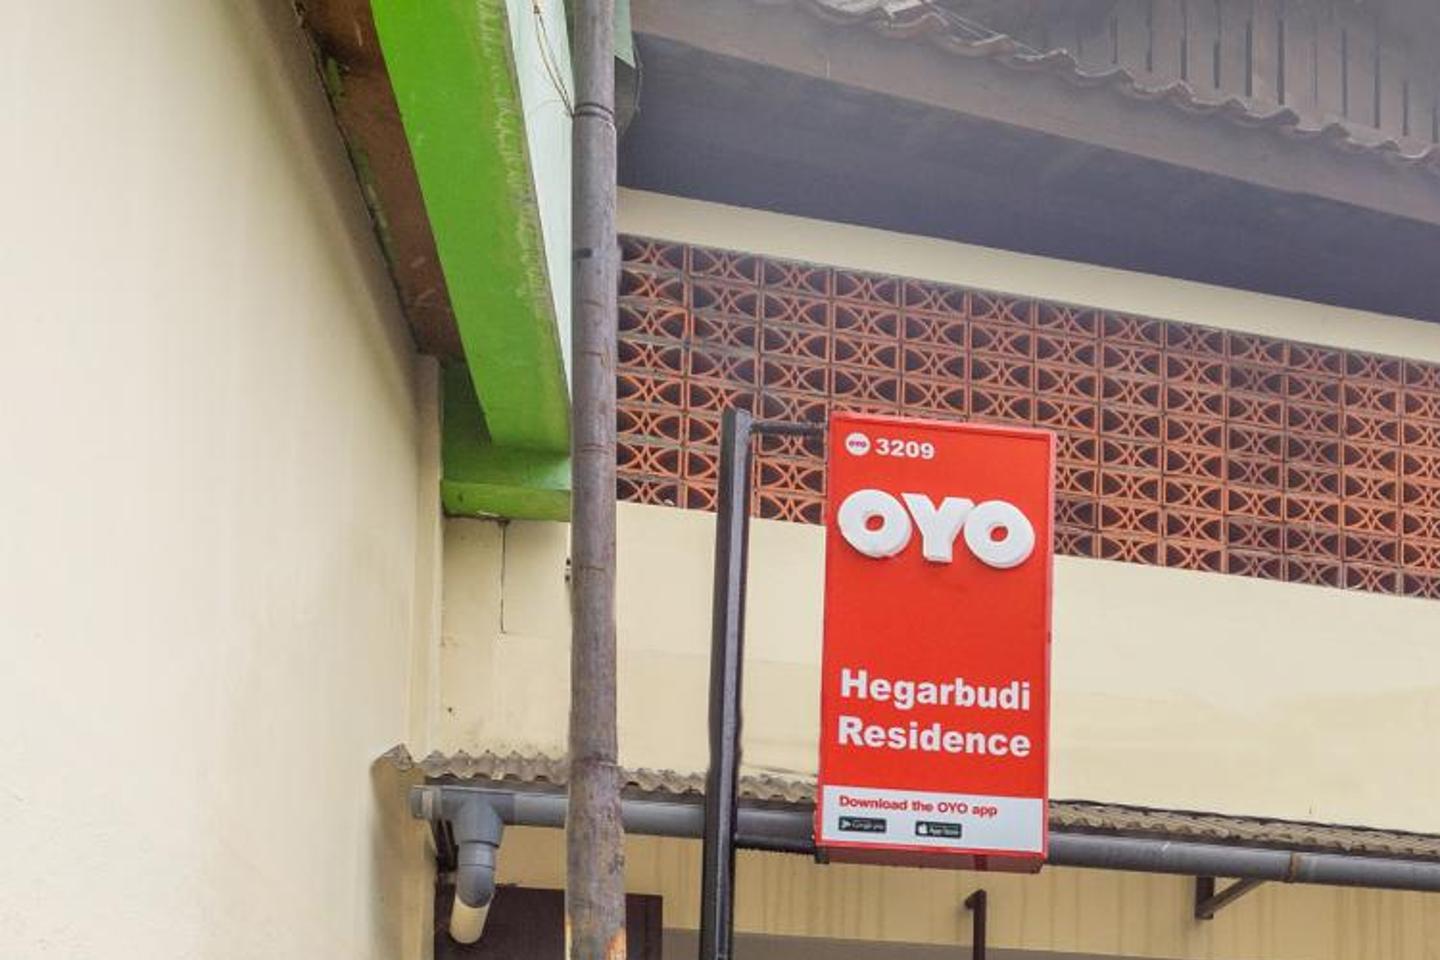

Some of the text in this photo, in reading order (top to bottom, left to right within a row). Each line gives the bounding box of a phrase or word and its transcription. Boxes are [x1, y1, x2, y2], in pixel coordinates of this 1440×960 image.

[875, 437, 935, 459] 3209
[837, 489, 1036, 569] OYO
[841, 668, 1031, 710] Hegarbudi
[838, 715, 1031, 757] Residence
[839, 796, 998, 818] Download the OYO app
